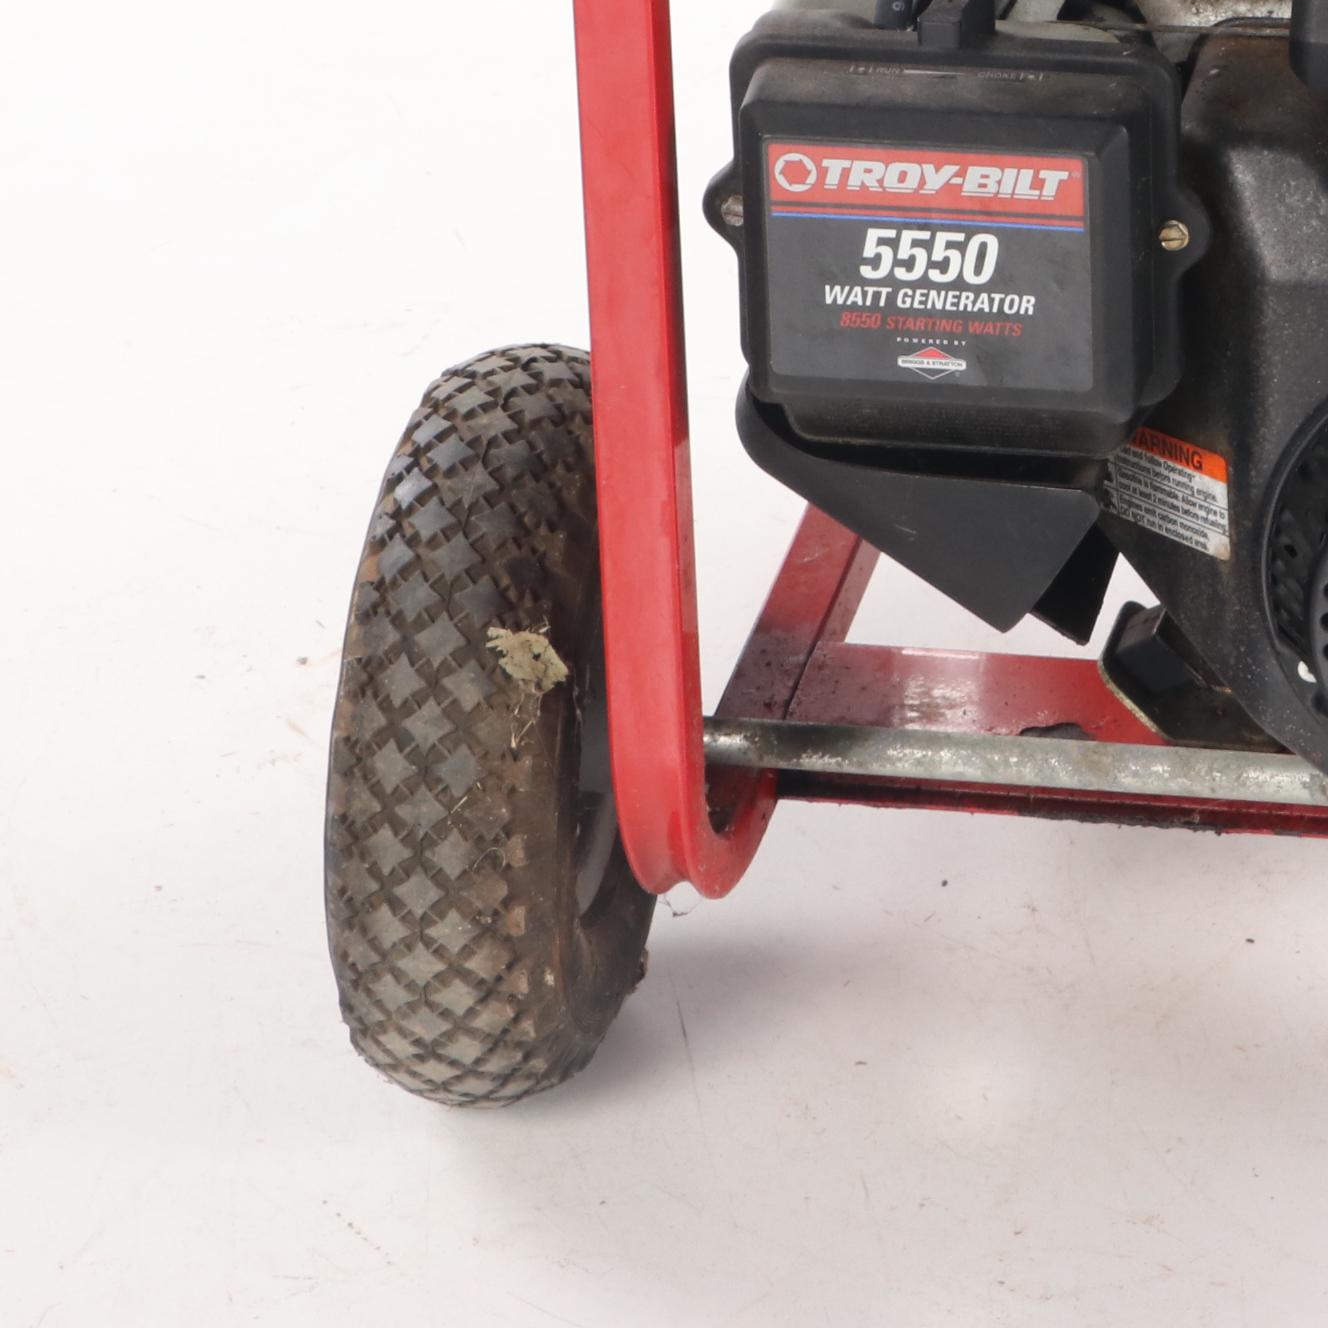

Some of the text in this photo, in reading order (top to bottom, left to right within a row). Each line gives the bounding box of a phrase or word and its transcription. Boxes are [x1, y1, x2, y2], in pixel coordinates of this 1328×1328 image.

[820, 159, 1069, 200] TROY-BILT
[859, 228, 1000, 285] 5550
[824, 284, 1036, 315] WATT GENERATOR
[840, 312, 1022, 337] 8550 STARTING WATTS
[896, 337, 948, 345] POWERED
